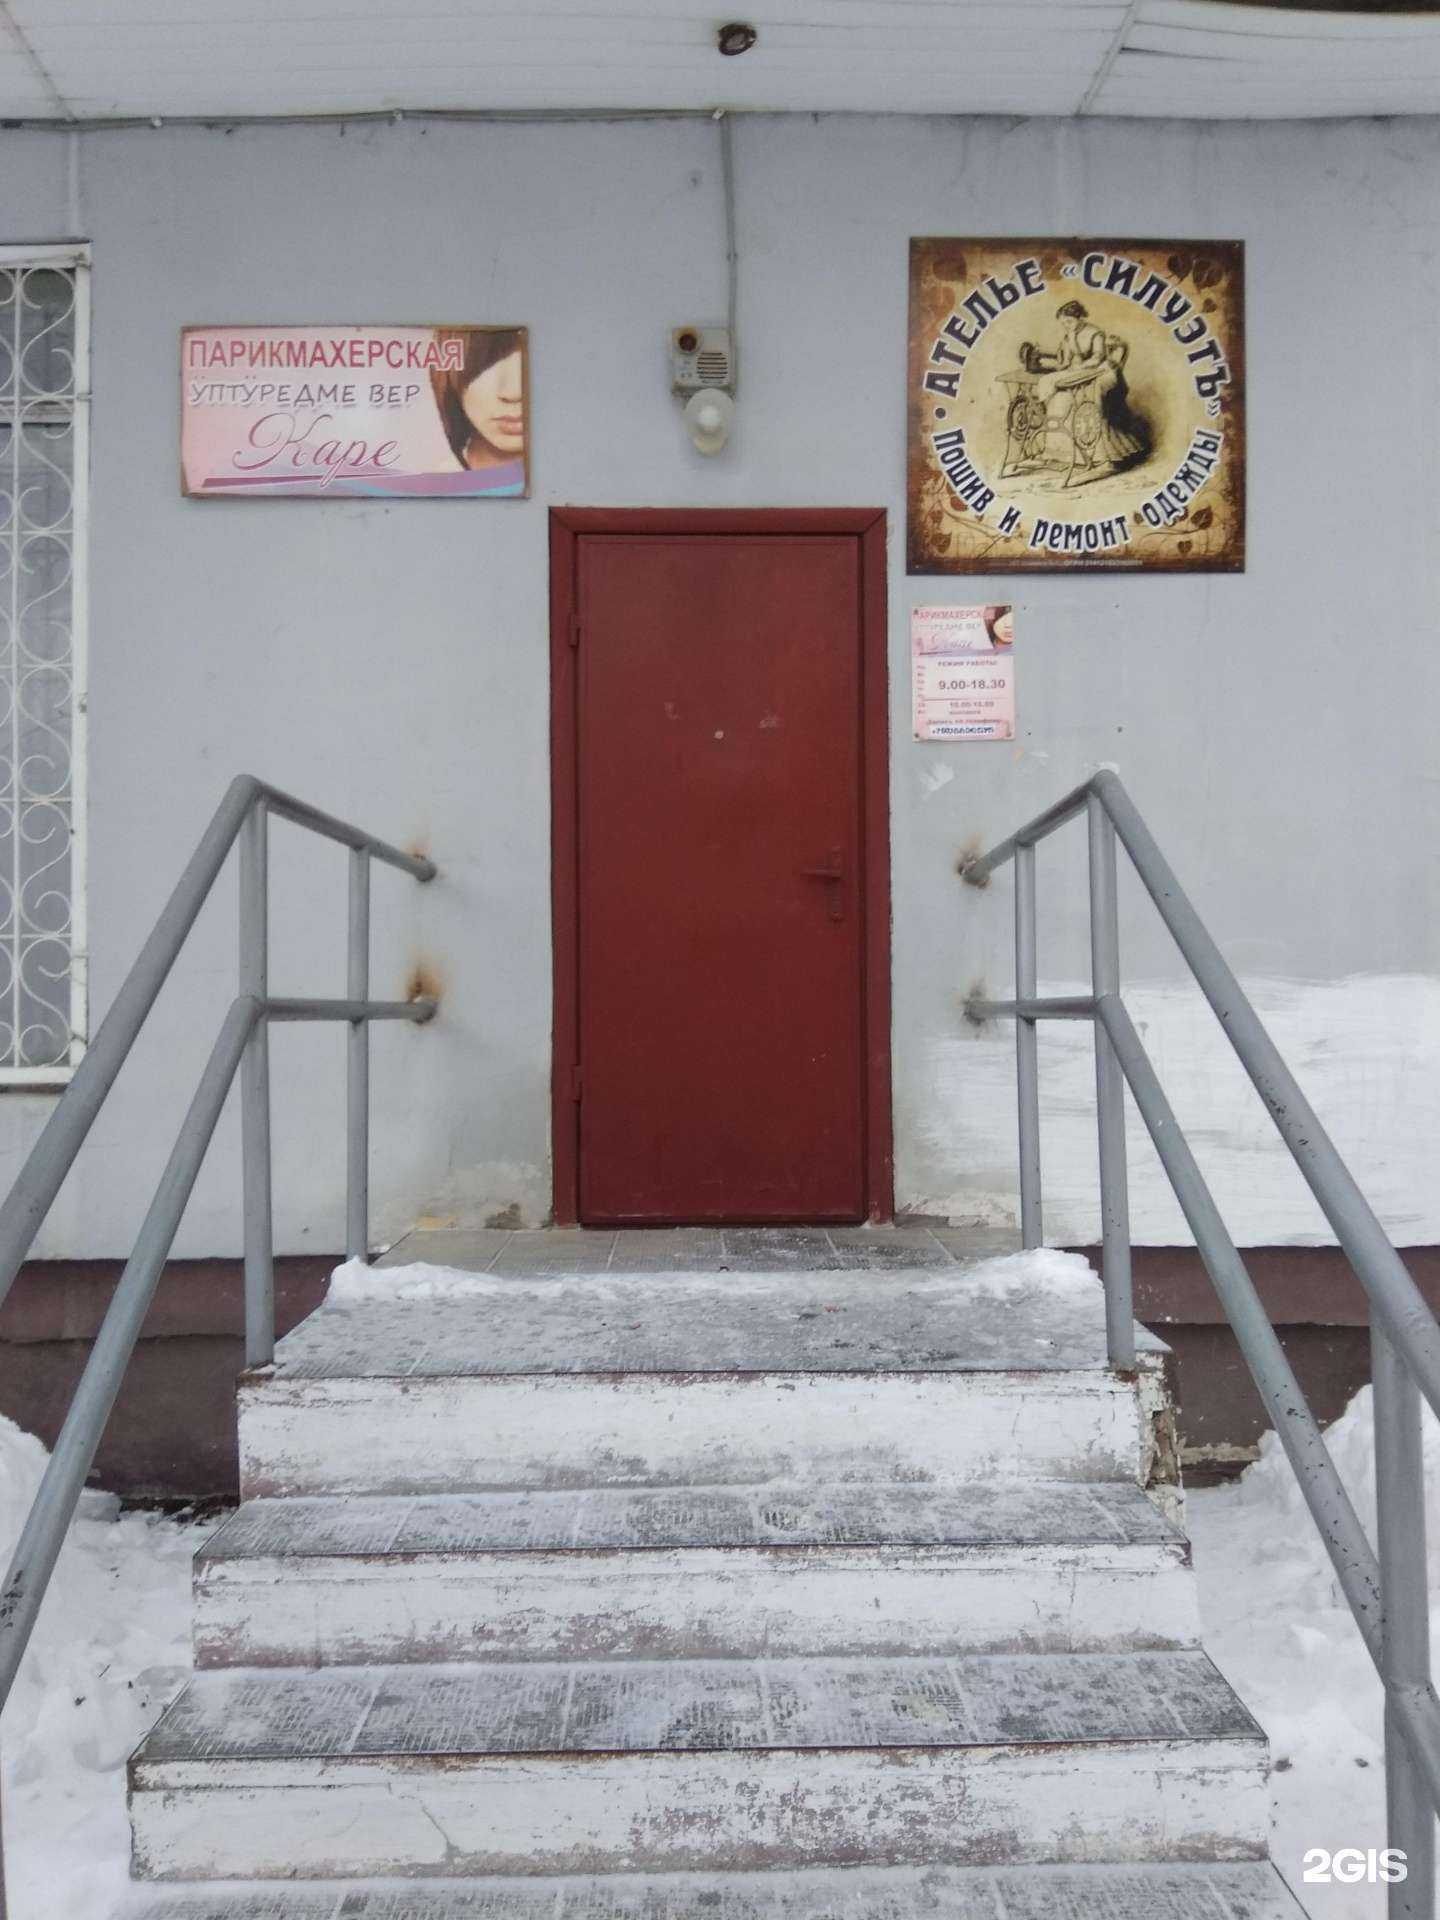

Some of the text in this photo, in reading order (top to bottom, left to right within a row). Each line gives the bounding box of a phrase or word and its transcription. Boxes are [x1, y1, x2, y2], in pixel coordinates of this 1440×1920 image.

[924, 260, 1045, 397] АТЕЛЬЕ
[190, 339, 463, 369] ПАРИКМАХЕРСКАЯ
[369, 384, 420, 403] ВЕР
[231, 412, 402, 487] Каре
[938, 679, 1006, 690] 9.00-18.30
